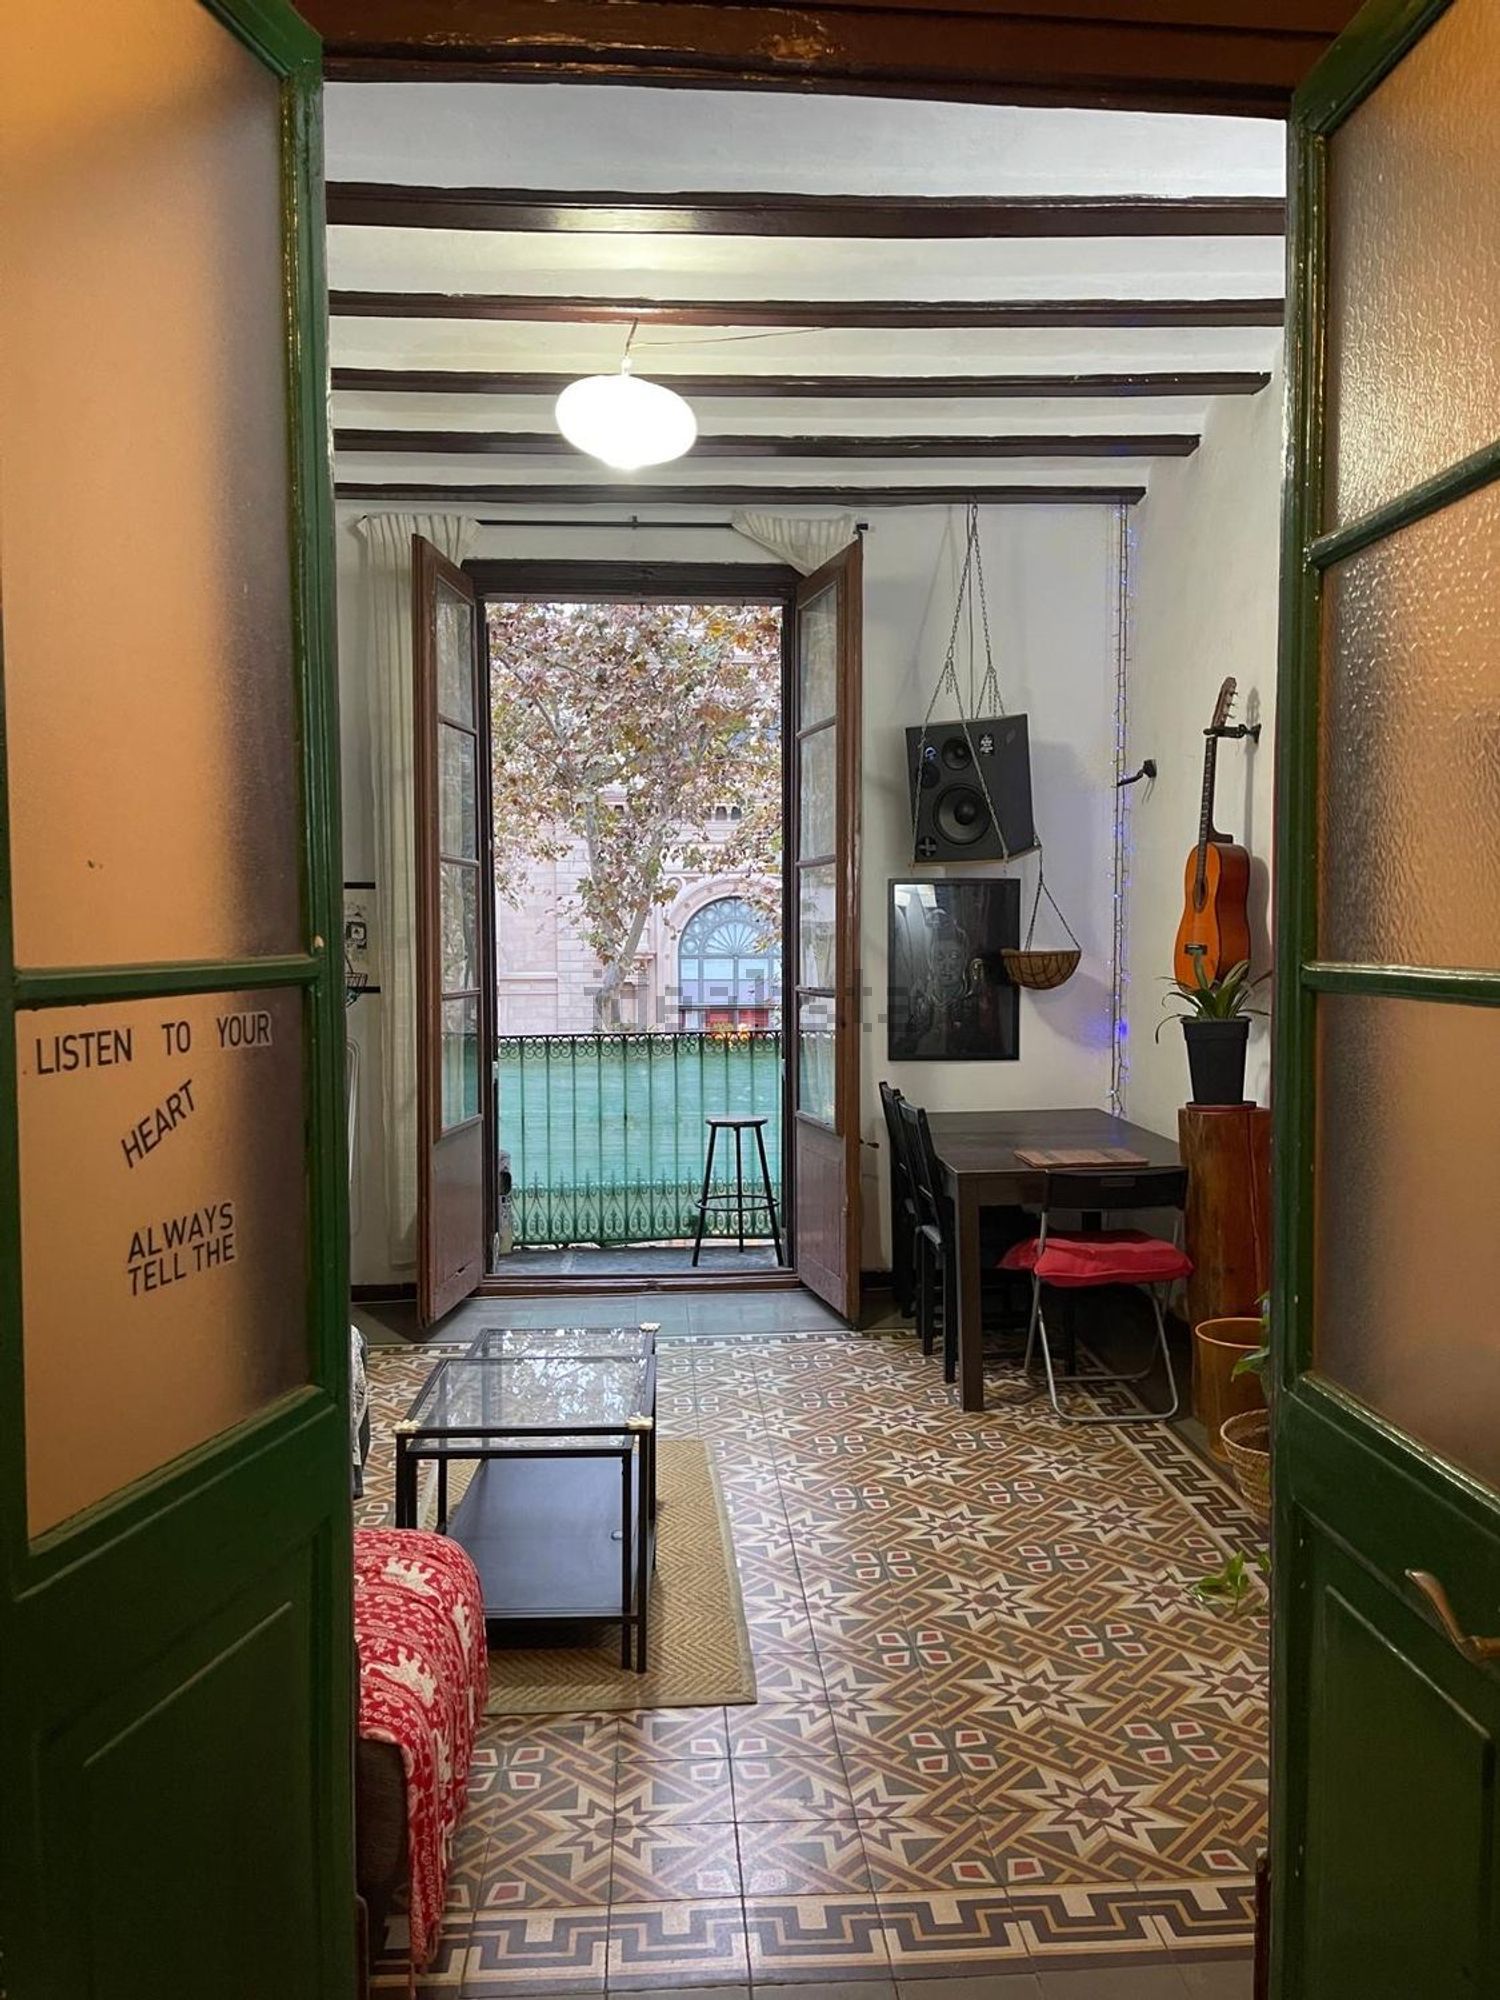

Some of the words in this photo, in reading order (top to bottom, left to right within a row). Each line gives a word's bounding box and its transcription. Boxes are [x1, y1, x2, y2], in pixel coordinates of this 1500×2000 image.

[35, 1027, 133, 1076] LISTEN
[161, 1020, 192, 1057] TO
[216, 1013, 271, 1049] YOUR
[120, 1078, 196, 1169] HEART
[126, 1202, 235, 1264] ALWAYS
[127, 1252, 188, 1297] TELL
[191, 1232, 236, 1273] THE
